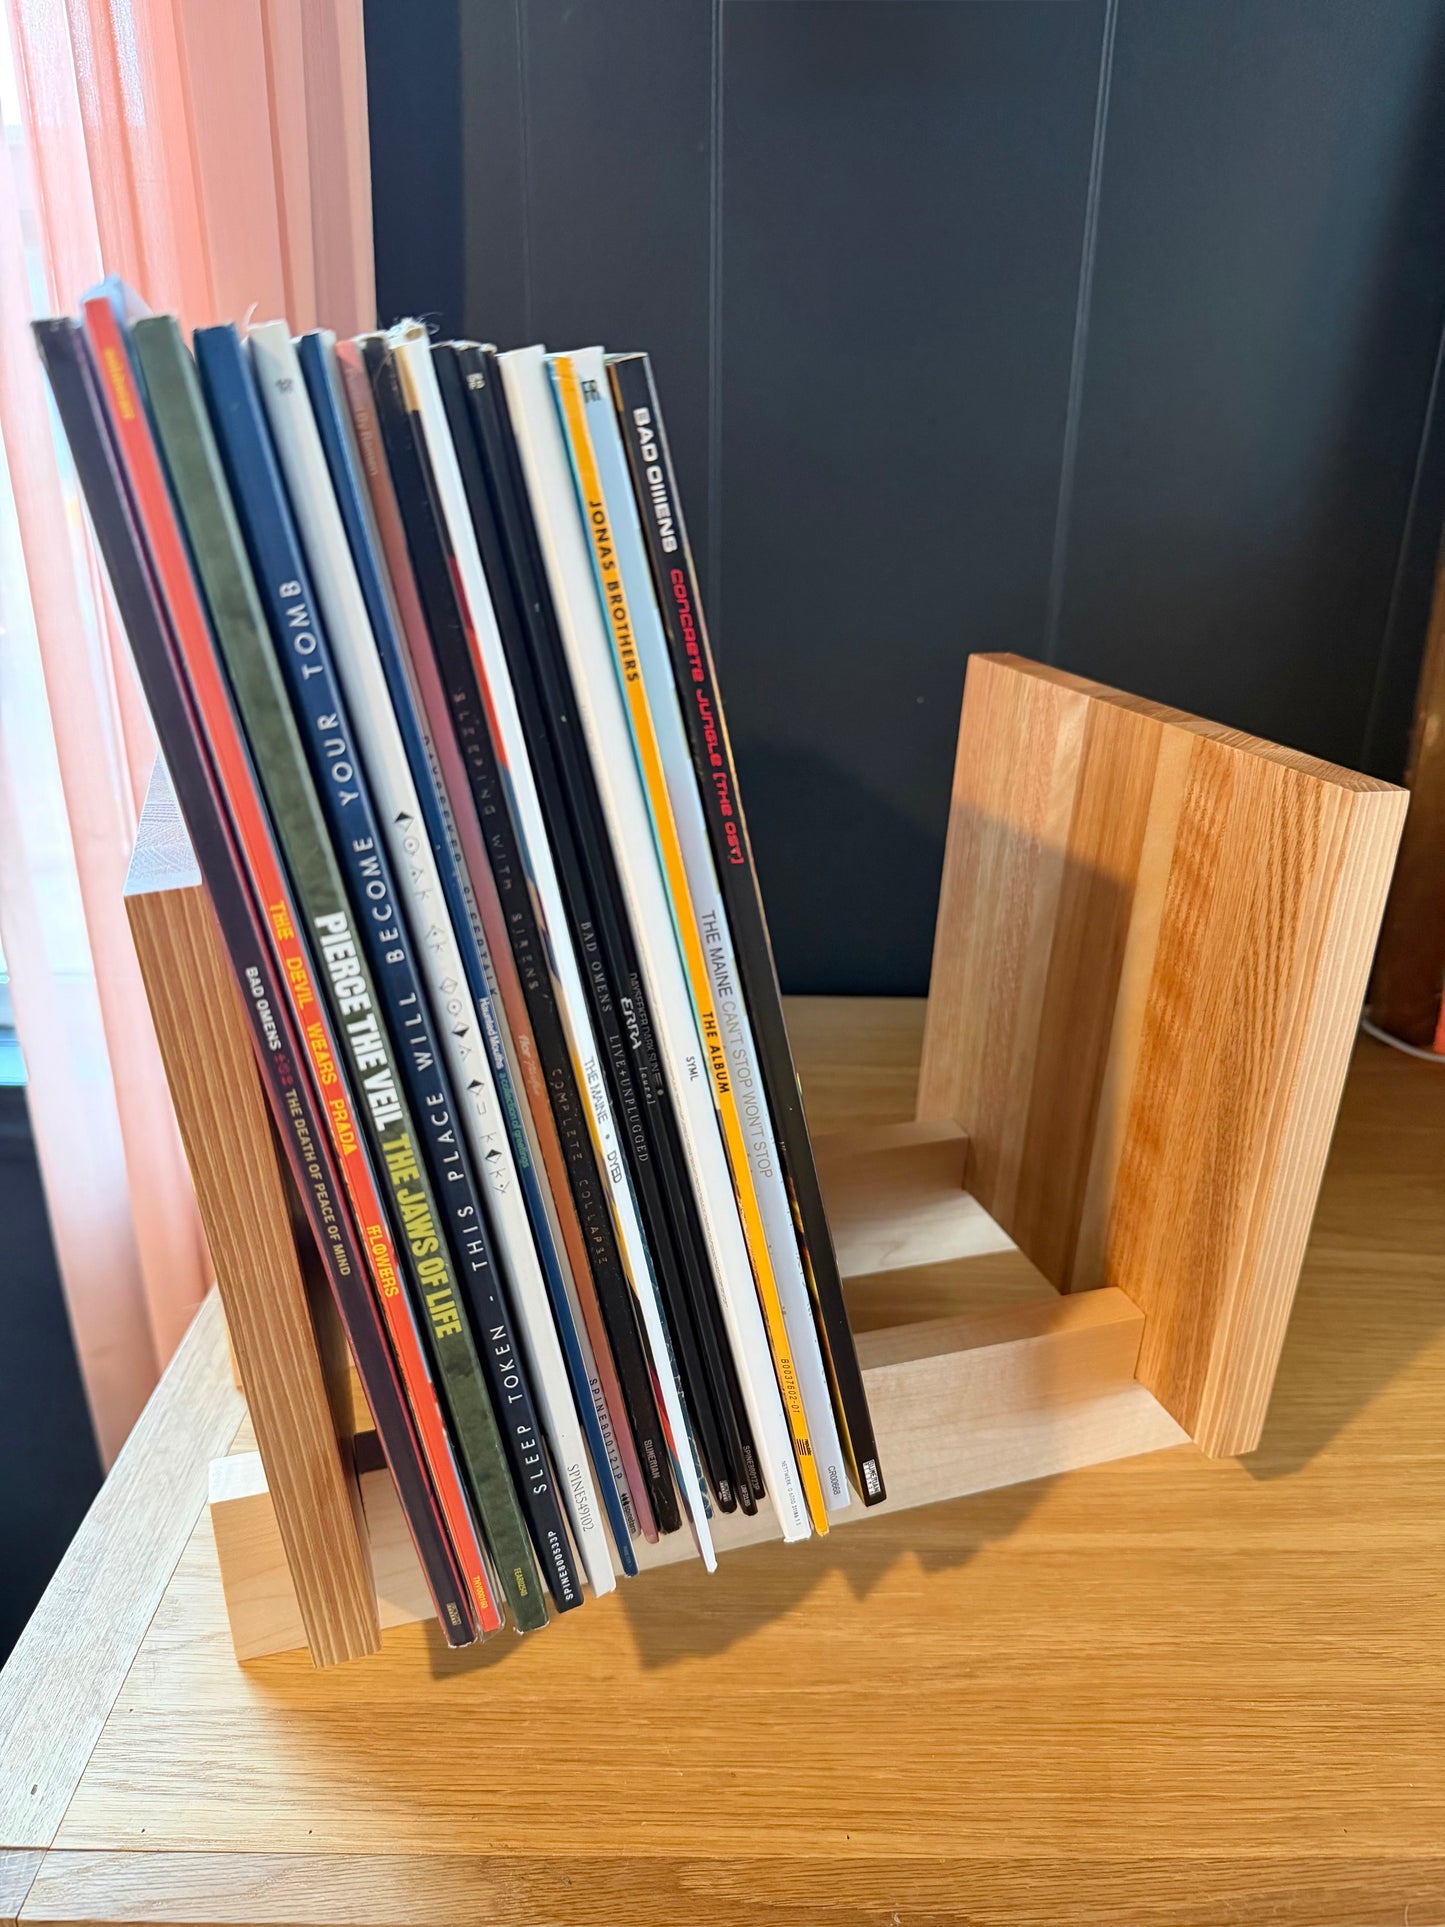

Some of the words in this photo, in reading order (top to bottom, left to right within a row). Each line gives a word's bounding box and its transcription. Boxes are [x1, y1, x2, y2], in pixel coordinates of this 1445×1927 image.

[633, 406, 658, 462] BAD
[646, 465, 678, 553] OMENS
[589, 500, 616, 571] JONAS
[607, 581, 640, 682] BROTHERS
[279, 580, 324, 680] TOMB
[696, 688, 723, 767] JUNGLE
[317, 712, 359, 806] YOUR
[453, 691, 496, 815] SLEEPING
[491, 834, 512, 890] WITH
[511, 912, 539, 989] SIRENS
[352, 836, 405, 965] BECOME
[701, 909, 721, 944] THE
[245, 966, 265, 998] BAD
[313, 911, 372, 1016] PIERCE
[580, 921, 597, 952] BAD
[591, 961, 612, 1012] OMENS
[709, 948, 733, 997] MAINE
[255, 999, 282, 1051] OMENS
[269, 900, 295, 941] THE
[286, 956, 314, 1010] DEVIL
[306, 1021, 338, 1086] WEARS
[329, 1098, 358, 1156] PRADA
[346, 1012, 388, 1072] THE
[398, 992, 434, 1072] WILL
[621, 996, 642, 1050] ERRA
[702, 1011, 718, 1038] THE
[721, 999, 743, 1045] CAN'T
[480, 997, 498, 1035] Haunted
[489, 1035, 505, 1070] Mouths
[501, 1078, 518, 1120] collection
[584, 1055, 599, 1081] THE
[685, 1055, 699, 1082] SYML
[709, 1046, 730, 1094] ALBUM
[732, 1045, 753, 1091] STOP
[285, 1088, 302, 1117] THE
[362, 1067, 404, 1132] VEIL
[590, 1081, 608, 1124] MAINE
[742, 1091, 764, 1137] WON'T
[294, 1118, 317, 1163] DEATH
[382, 1132, 420, 1185] THE
[427, 1093, 465, 1183] PLACE
[753, 1138, 773, 1178] STOP
[308, 1163, 322, 1181] OF
[552, 1068, 583, 1161] COMPLETE
[580, 1179, 608, 1265] COLLAPSE
[607, 1150, 622, 1184] DYED
[314, 1182, 335, 1224] PEACE
[396, 1187, 439, 1257] JAWS
[327, 1224, 341, 1242] OF
[457, 1205, 488, 1272] THIS
[333, 1243, 351, 1277] MIND
[366, 1224, 400, 1298] FLOWERS
[416, 1257, 449, 1288] OF
[426, 1287, 463, 1339] LIFE
[489, 1325, 523, 1404] TOKEN
[517, 1425, 548, 1494] SLEEP
[643, 1439, 661, 1479] SUMERIAN
[547, 1530, 574, 1601] SPINE800533P
